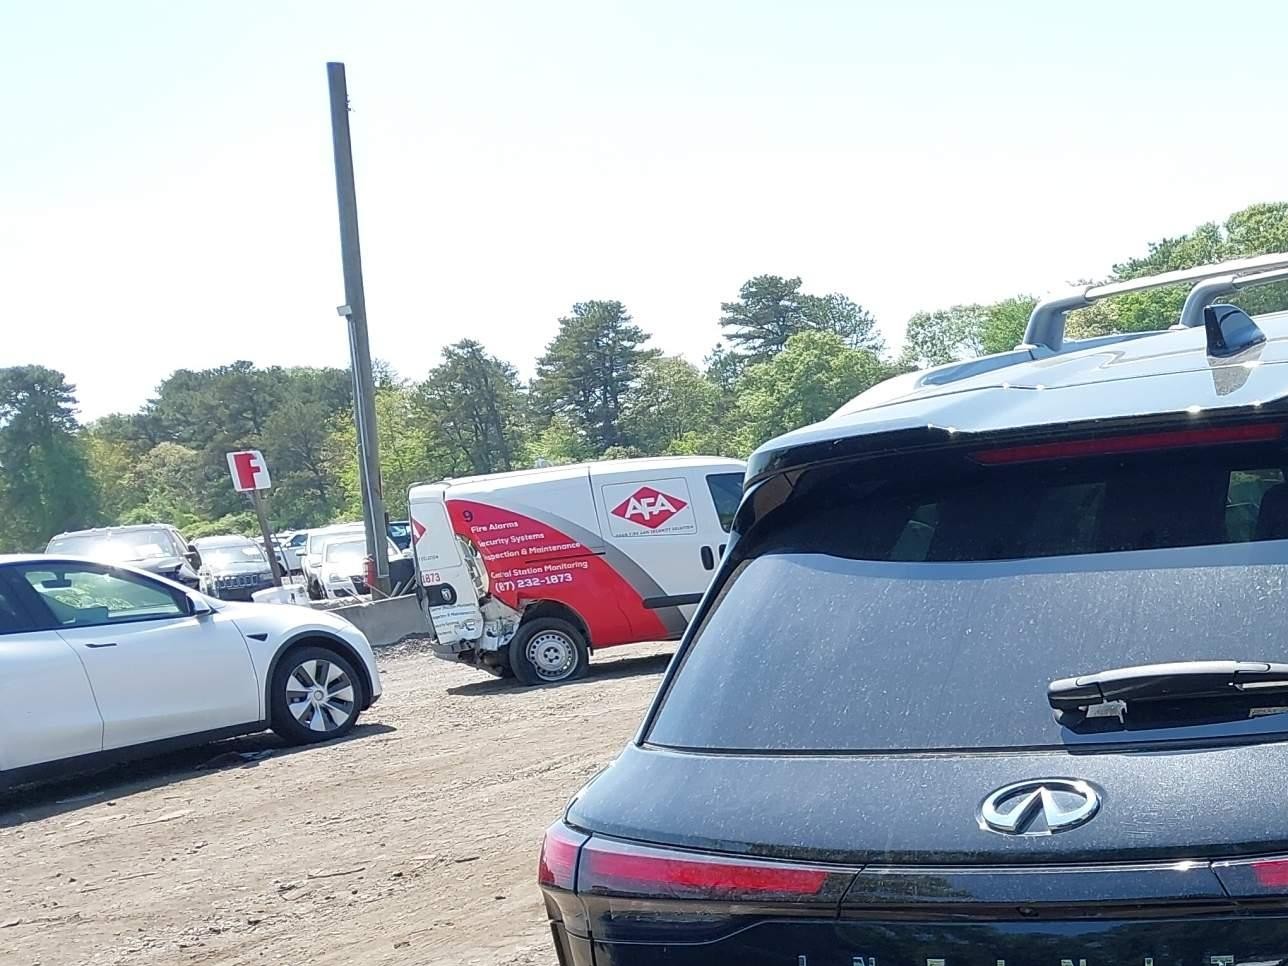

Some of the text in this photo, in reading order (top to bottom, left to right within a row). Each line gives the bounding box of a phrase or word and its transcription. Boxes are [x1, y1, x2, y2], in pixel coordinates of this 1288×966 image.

[233, 453, 261, 489] F
[625, 494, 677, 521] AFA
[462, 510, 474, 523] 9
[470, 520, 519, 534] Fire Alarms
[510, 532, 545, 545] Systems
[521, 548, 528, 556] &
[528, 541, 581, 555] Maintenance
[513, 567, 543, 578] Station
[544, 559, 589, 573] Monitoring
[517, 572, 573, 588] 232-1873
